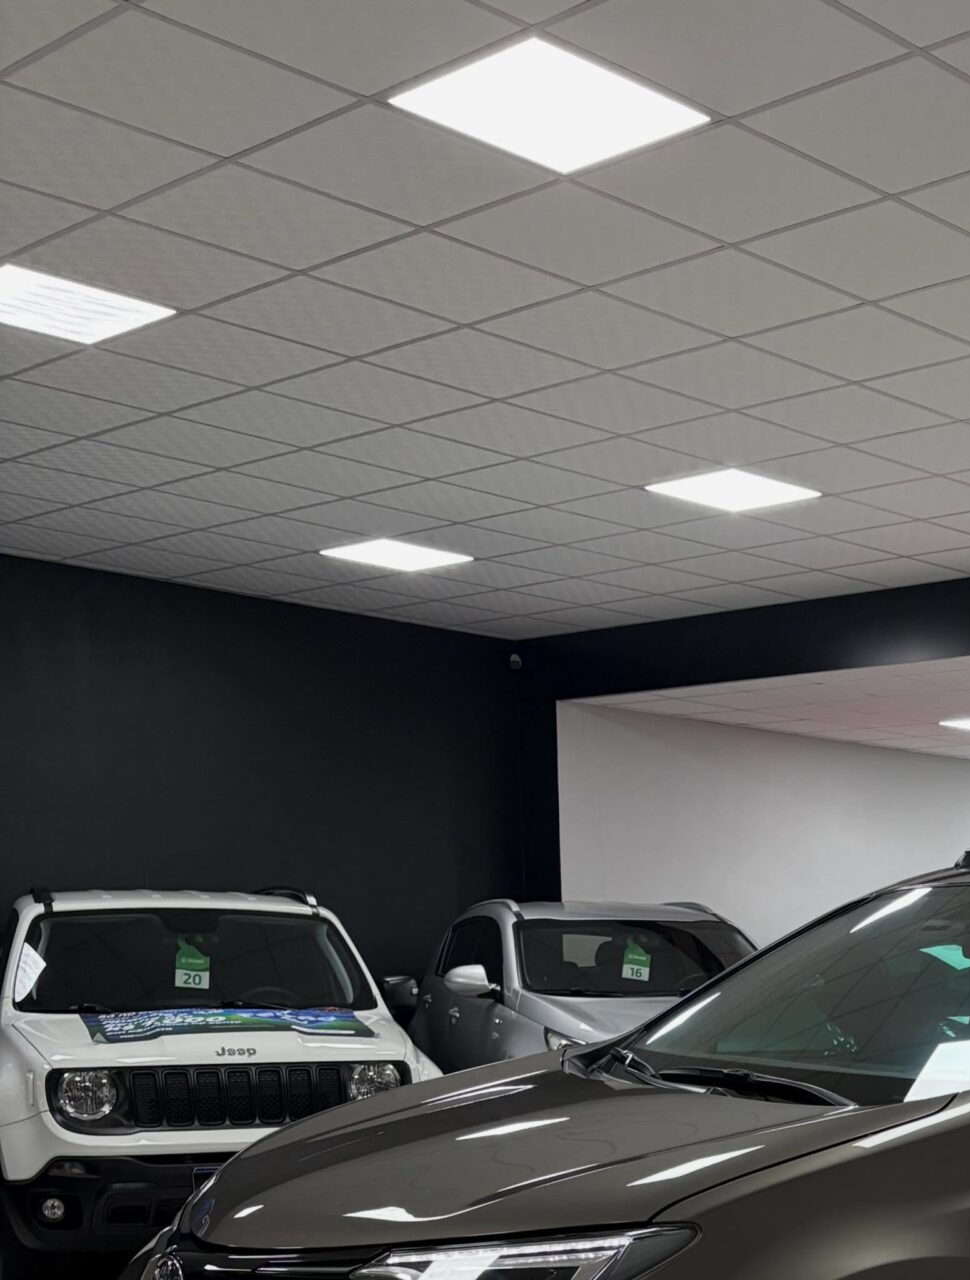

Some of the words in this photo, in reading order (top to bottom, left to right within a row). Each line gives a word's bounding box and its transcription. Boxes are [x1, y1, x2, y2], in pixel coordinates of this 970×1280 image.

[629, 967, 643, 978] 16
[183, 972, 202, 986] 20
[214, 1046, 257, 1058] Jeep
